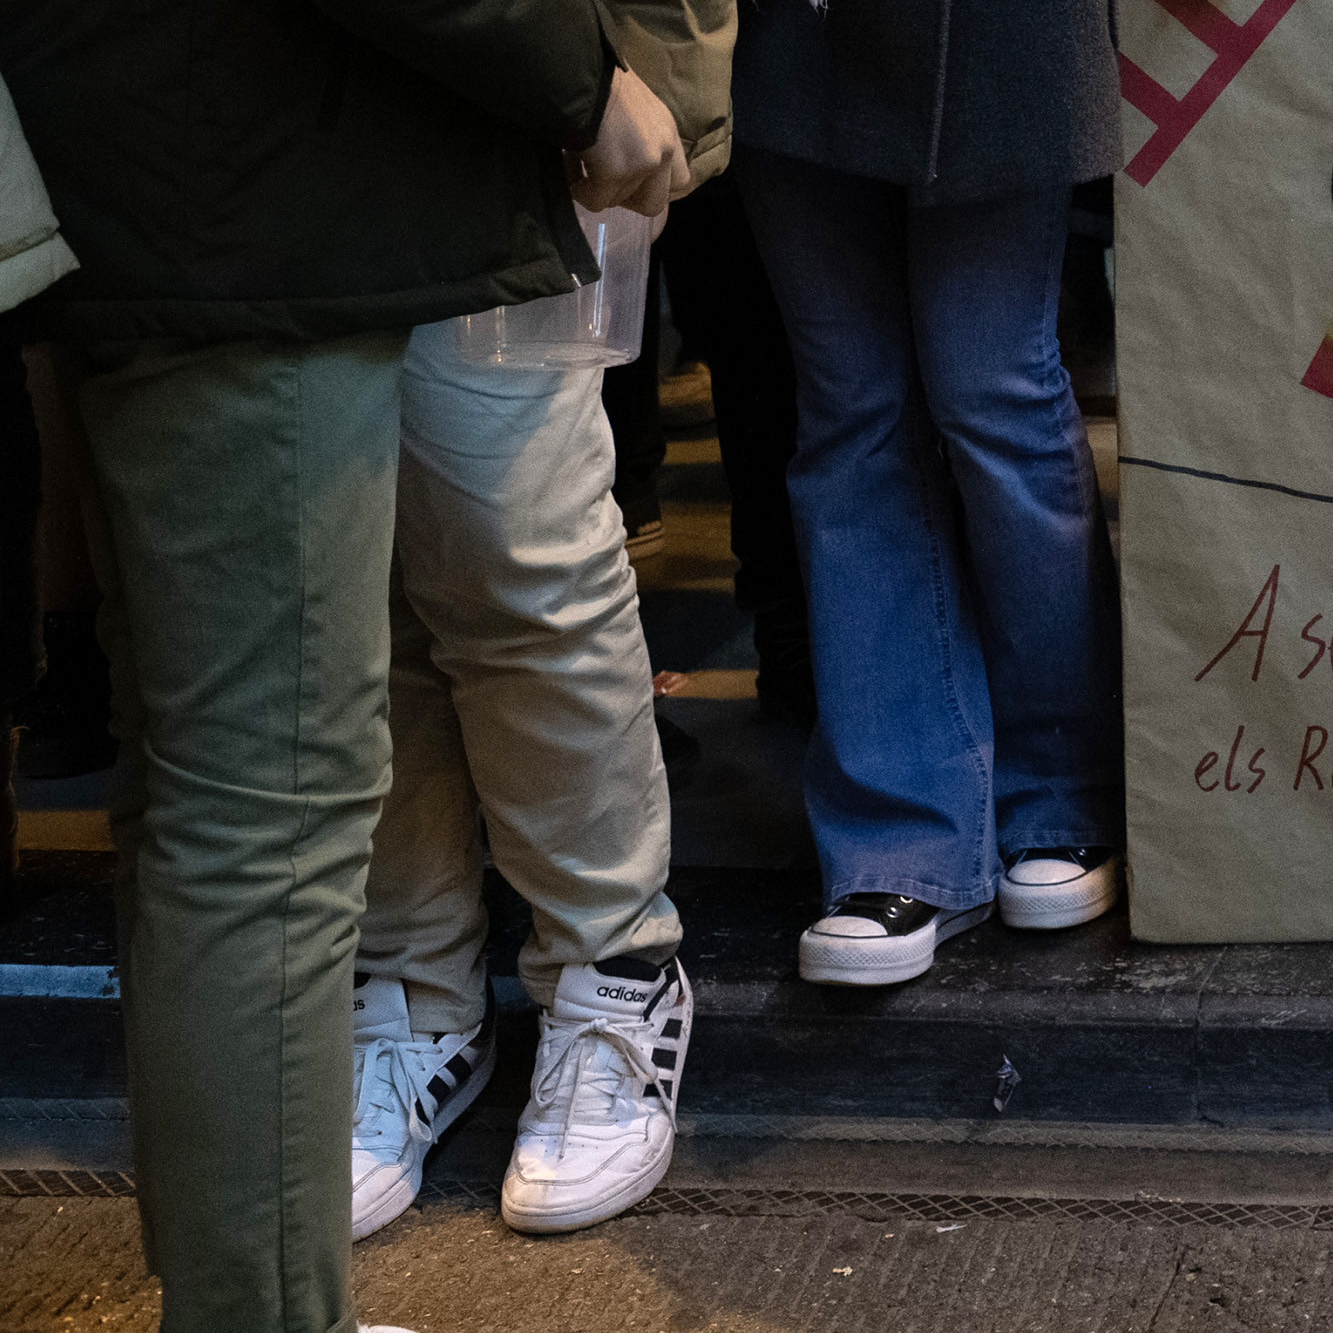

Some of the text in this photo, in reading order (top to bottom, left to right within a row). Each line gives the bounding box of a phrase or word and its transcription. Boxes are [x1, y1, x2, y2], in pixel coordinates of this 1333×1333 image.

[1195, 564, 1281, 683] A
[1194, 726, 1266, 794] els
[596, 985, 649, 1004] adidas
